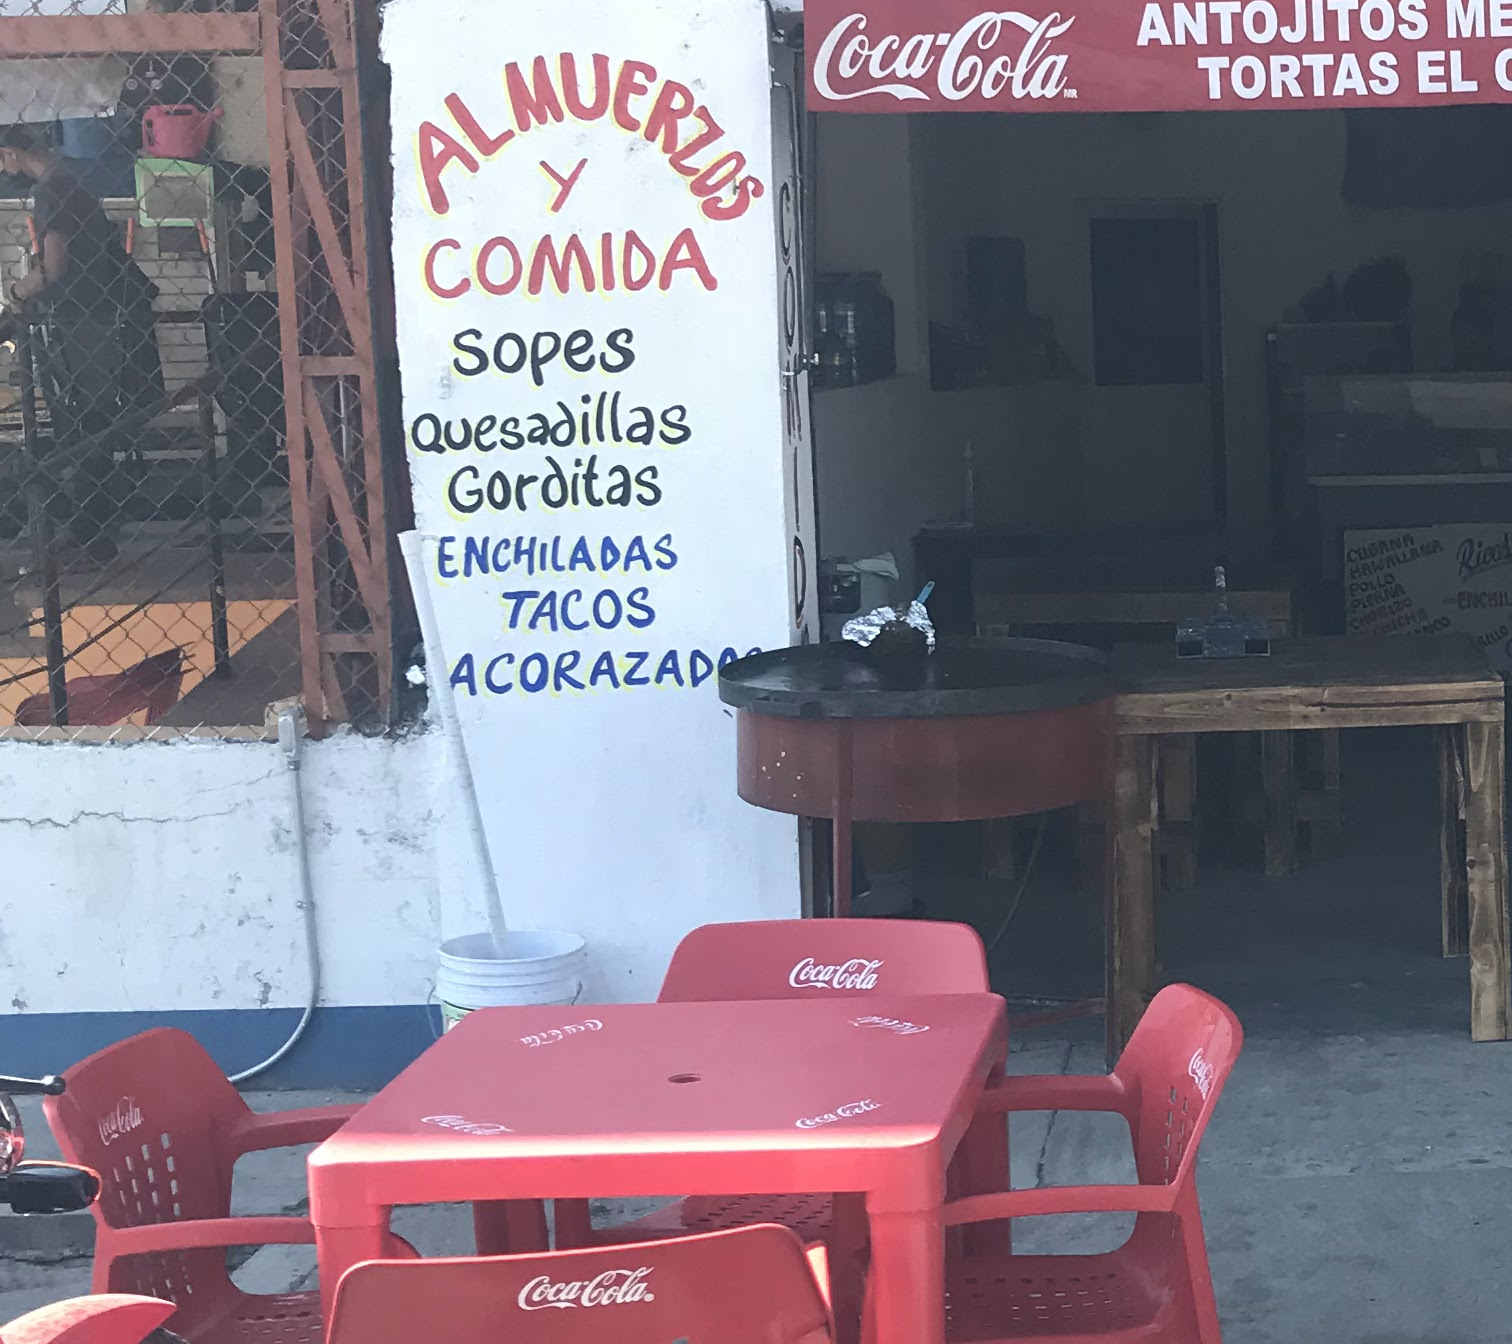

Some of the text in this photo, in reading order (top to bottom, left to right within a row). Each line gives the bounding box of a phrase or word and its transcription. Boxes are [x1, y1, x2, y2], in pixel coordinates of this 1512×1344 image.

[814, 10, 1076, 101] Coca-Cola
[1197, 53, 1400, 101] TORTAS
[1417, 50, 1478, 94] EL
[416, 51, 766, 222] ALMUERZOS
[538, 157, 589, 214] Y
[423, 227, 719, 301] COMIDA
[411, 390, 692, 454] Quesadillas
[446, 455, 663, 514] Gorditas
[437, 534, 678, 579] ENCHILADAS
[501, 587, 656, 632] TACOS
[1349, 572, 1396, 598] POLLO
[450, 646, 764, 697] ACORAZAD
[789, 957, 885, 991] Coca-Cola
[518, 1266, 655, 1312] Coca-Cola
